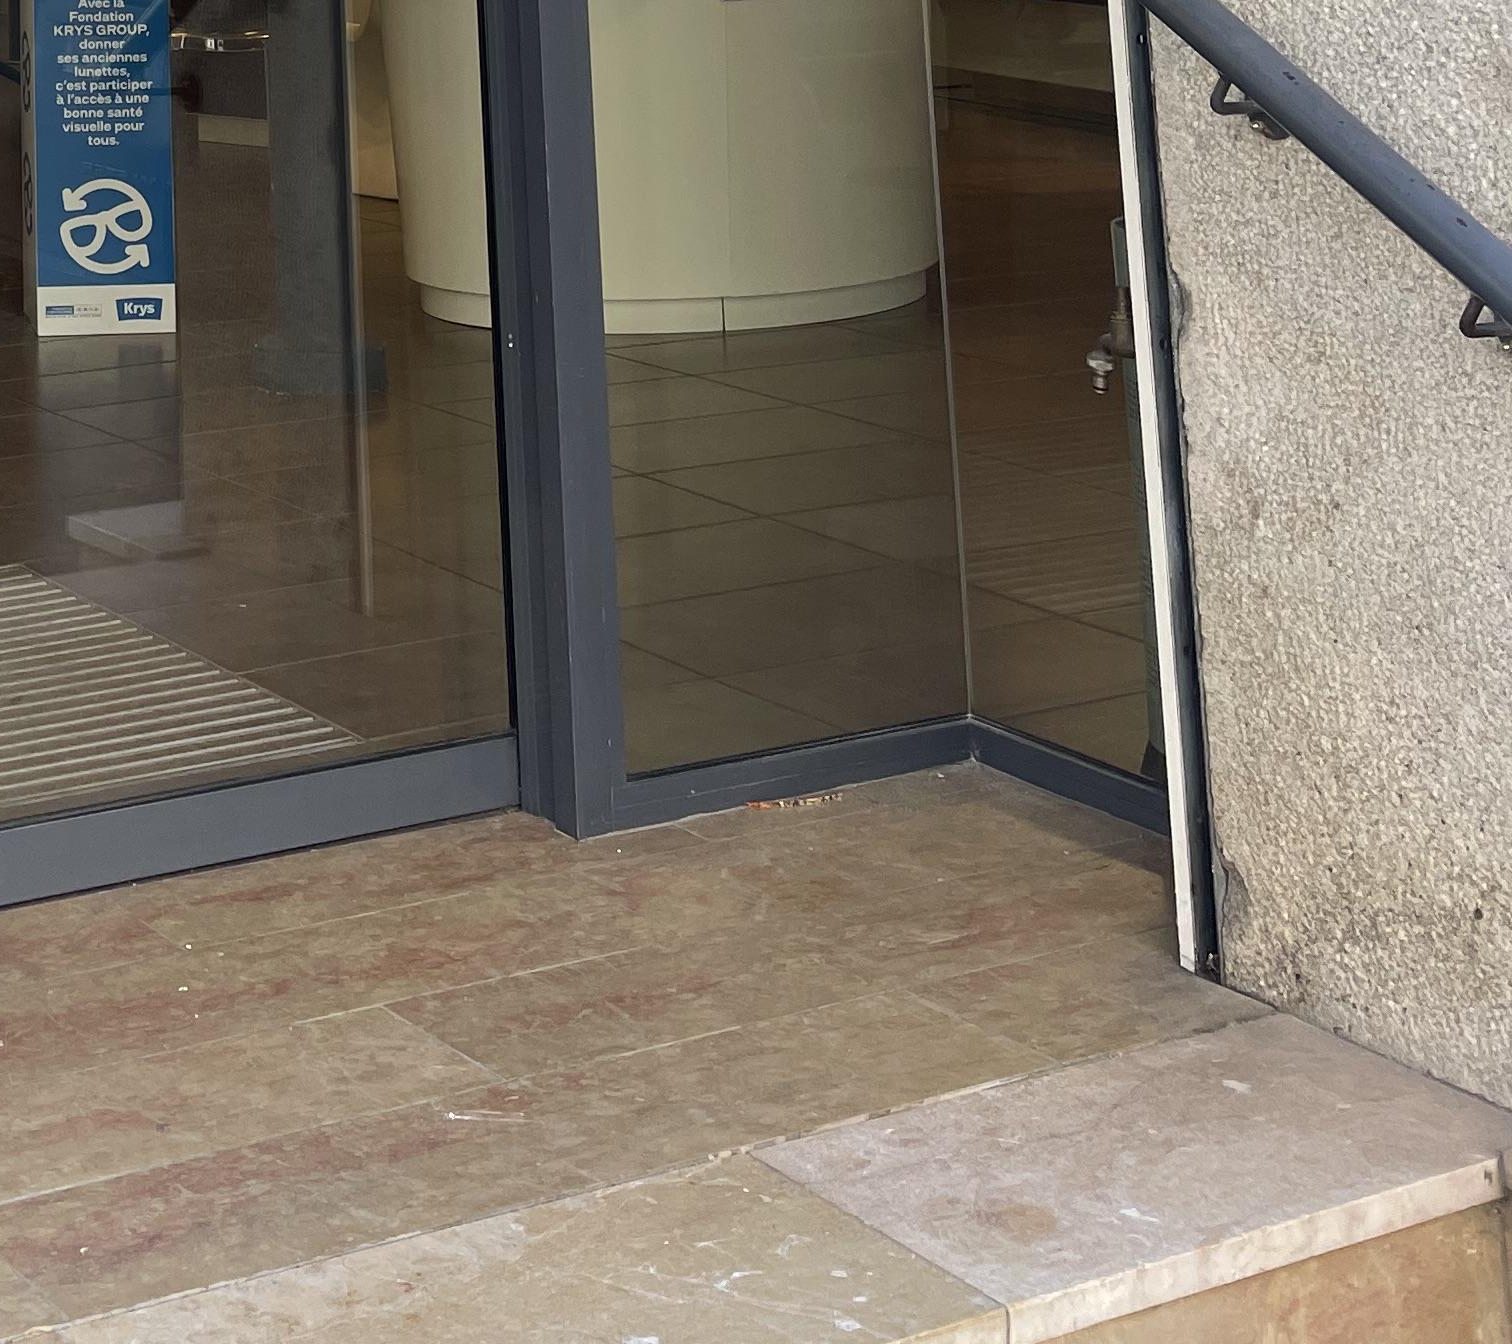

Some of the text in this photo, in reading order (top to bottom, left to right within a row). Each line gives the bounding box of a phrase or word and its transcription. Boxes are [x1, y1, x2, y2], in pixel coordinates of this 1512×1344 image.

[69, 11, 134, 23] Fondation
[53, 24, 150, 37] KRYS GROUP,
[79, 38, 126, 50] donner
[57, 52, 148, 64] ses anciennes
[74, 66, 131, 78] lunettes,
[55, 80, 153, 93] c'est participer
[56, 92, 150, 105] à l'accès à une
[63, 106, 143, 119] bonne santé
[62, 121, 145, 134] visuelle pour
[88, 135, 120, 146] tous.
[123, 302, 155, 317] Krys
